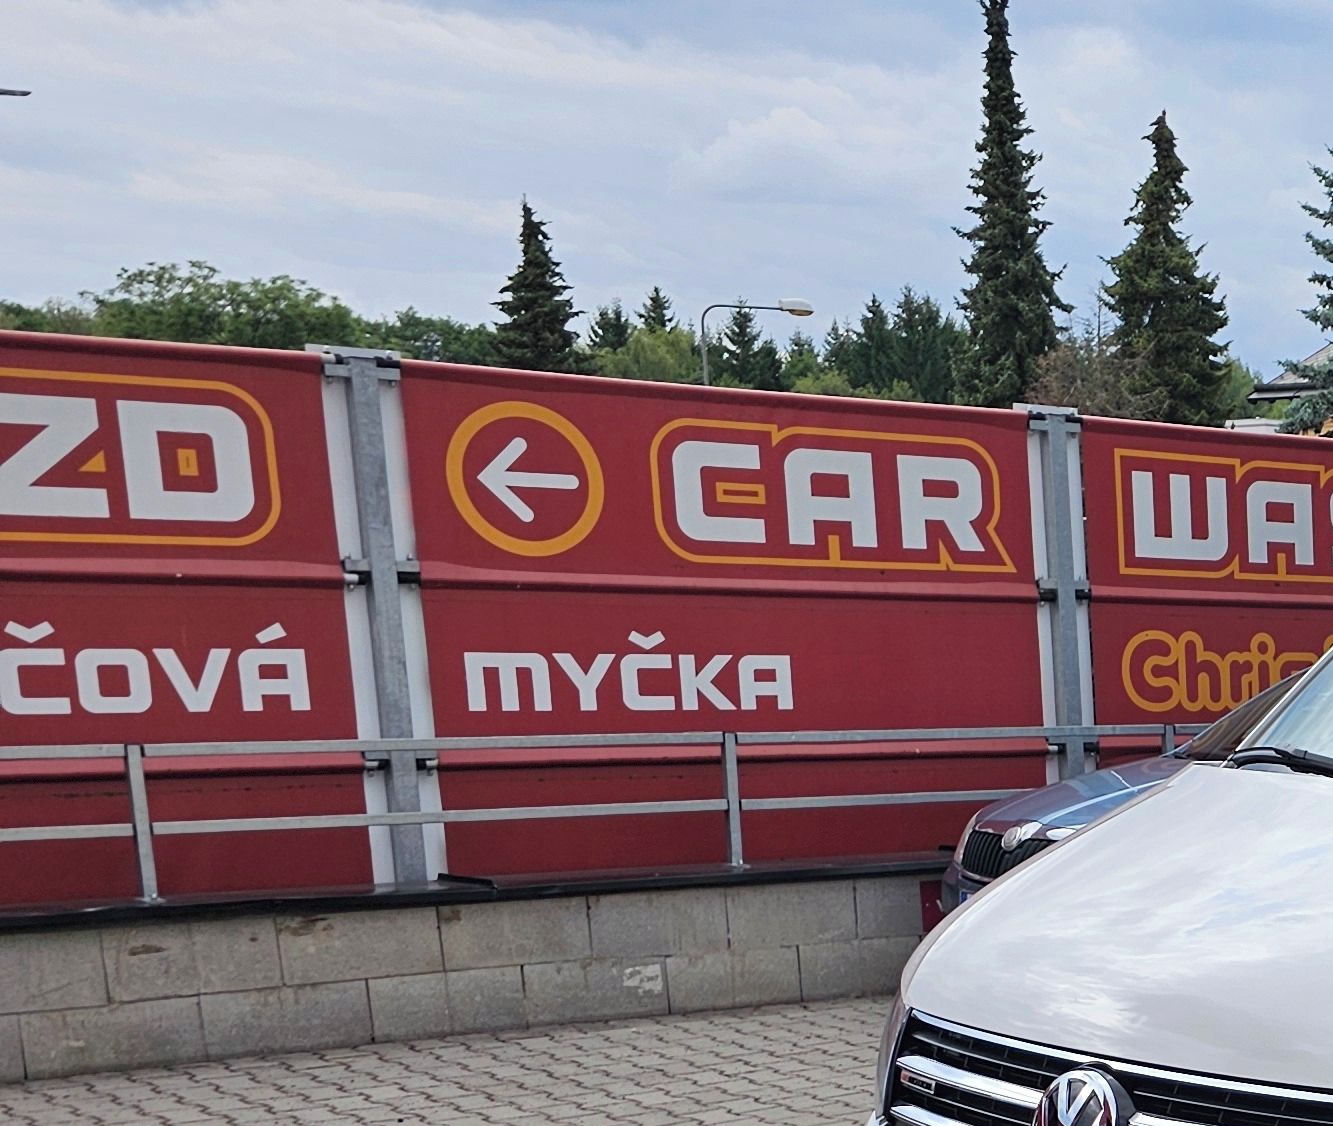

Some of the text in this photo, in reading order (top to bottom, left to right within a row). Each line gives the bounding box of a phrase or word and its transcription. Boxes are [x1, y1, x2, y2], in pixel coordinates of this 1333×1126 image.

[0, 392, 255, 522] ZD
[672, 440, 985, 552] CAR
[0, 620, 311, 715] ČOVÁ
[464, 630, 794, 711] MYČKA
